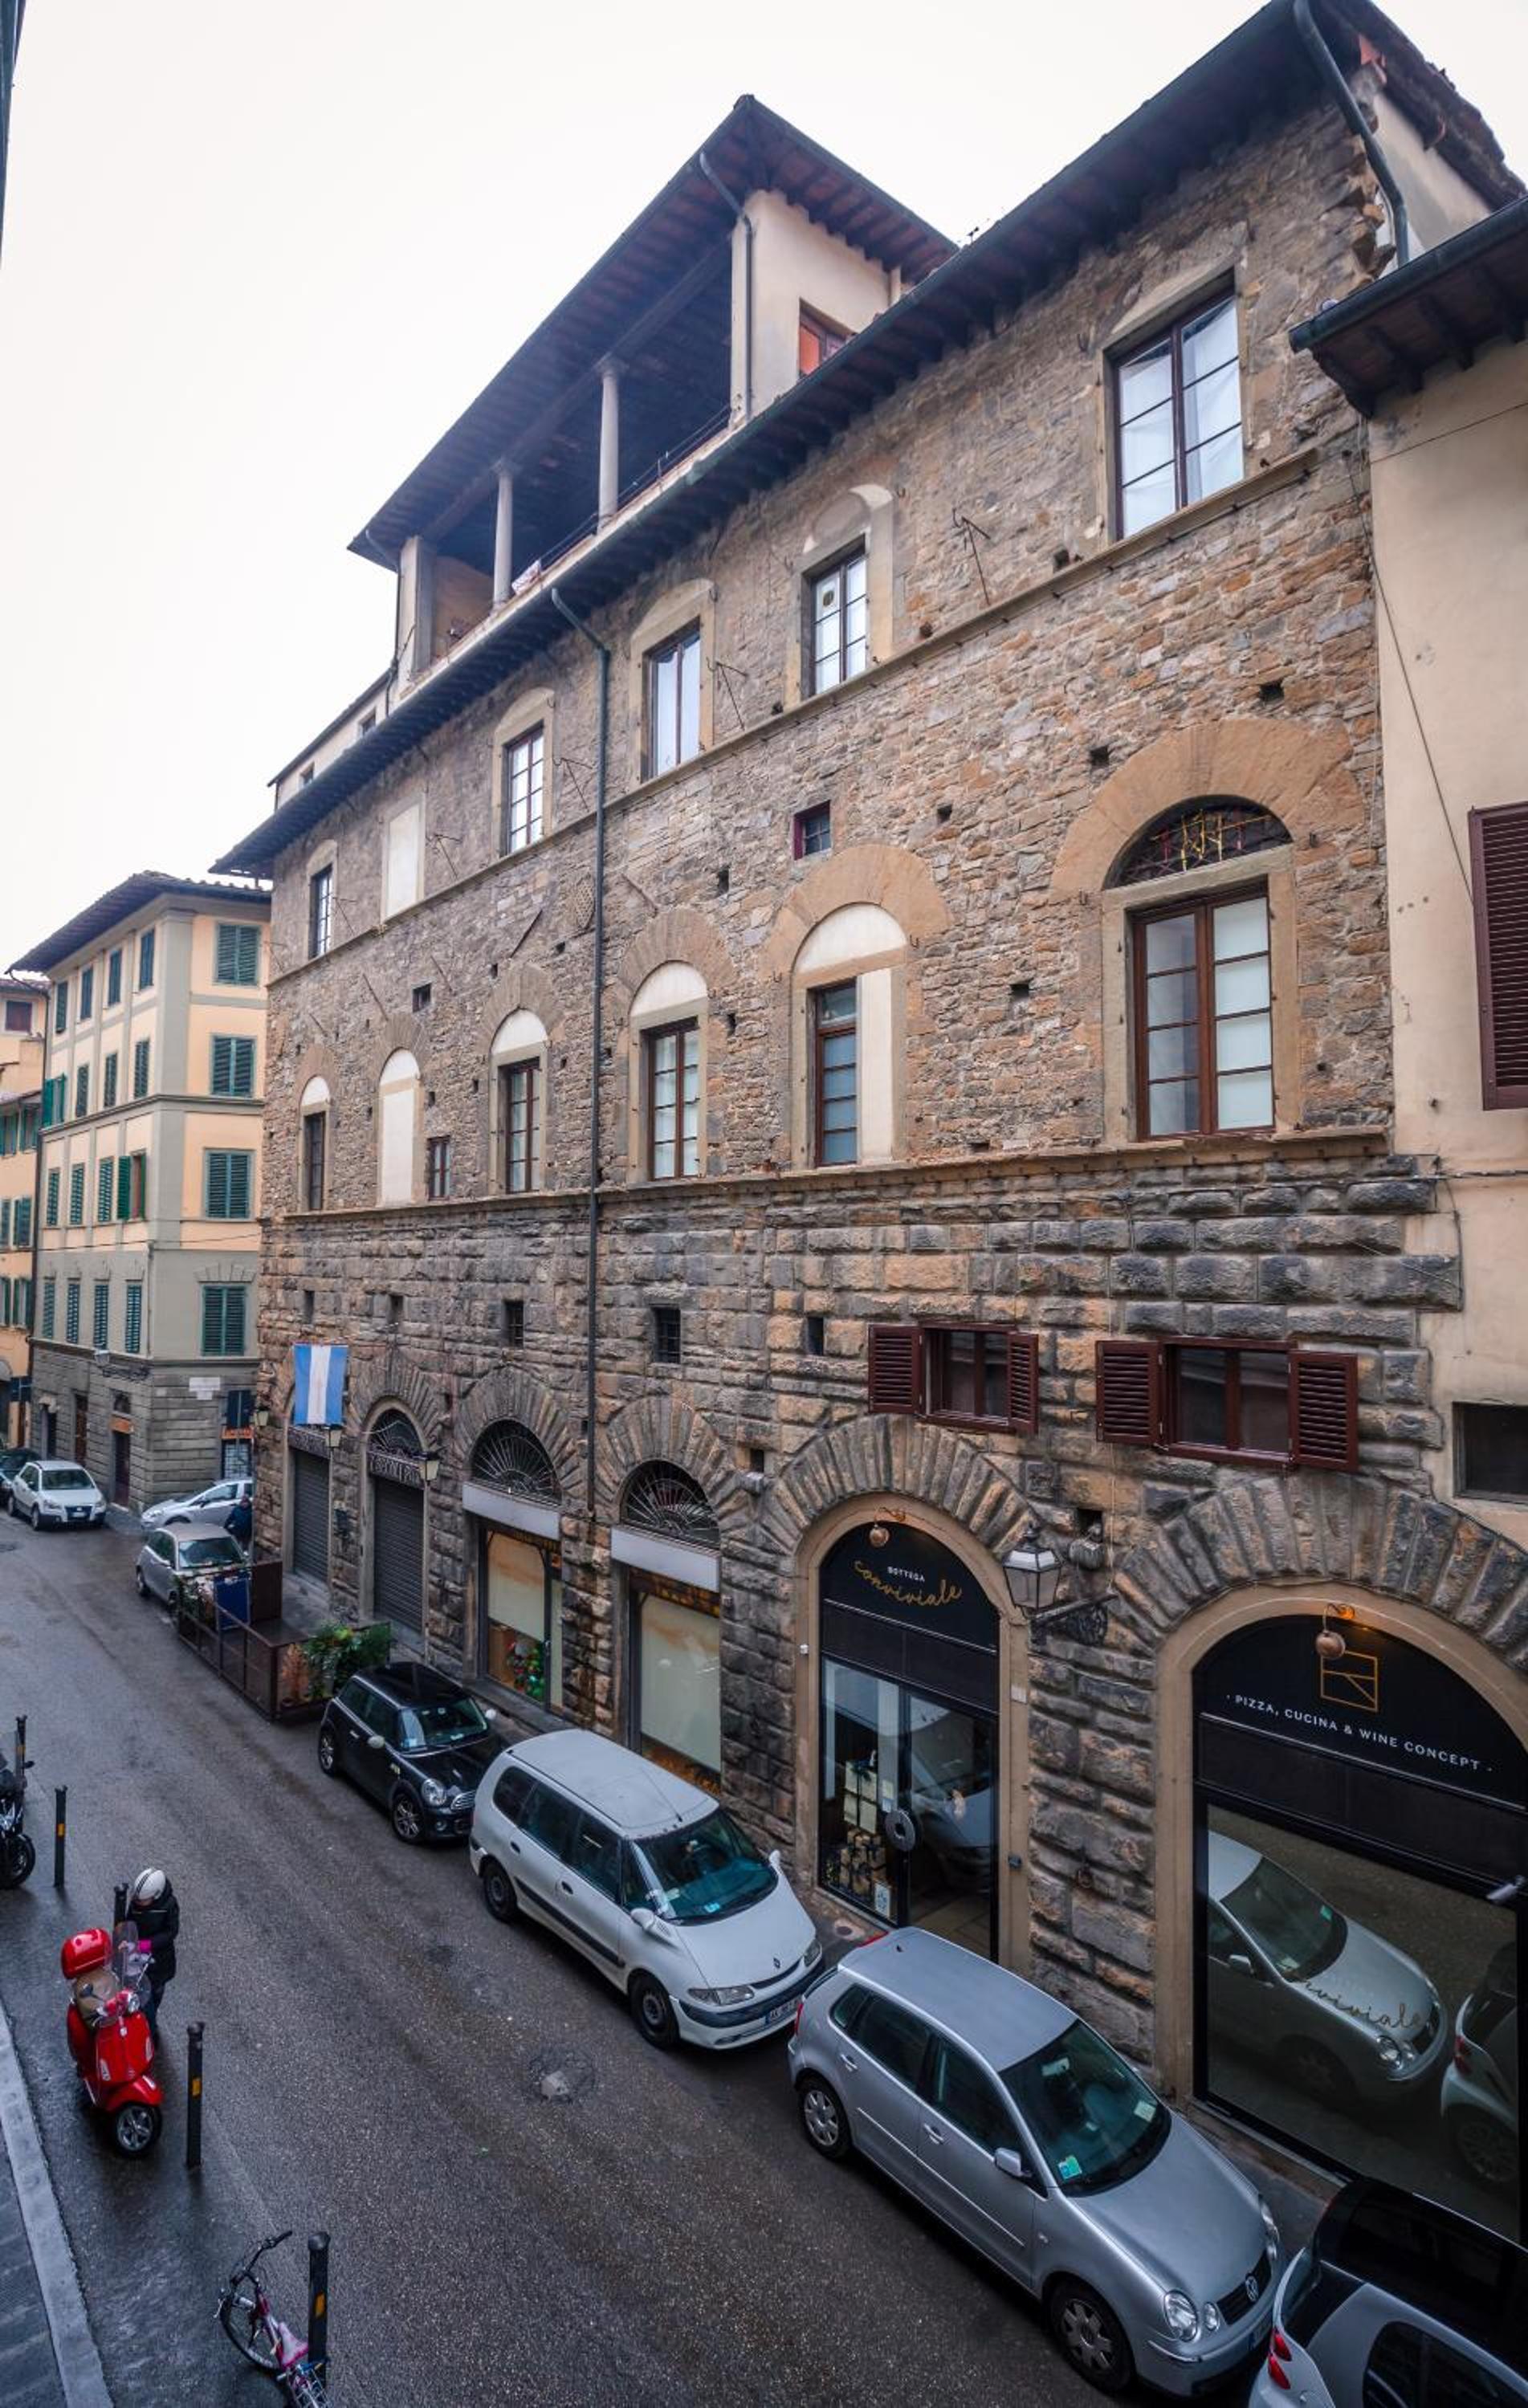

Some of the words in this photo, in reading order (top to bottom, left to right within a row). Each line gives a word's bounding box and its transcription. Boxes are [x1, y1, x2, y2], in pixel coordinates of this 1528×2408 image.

[887, 1566, 925, 1582] BOTTEGA
[1235, 1694, 1279, 1716] PIZZA,
[1285, 1709, 1338, 1731] CUCINA
[1343, 1724, 1353, 1735] &
[1359, 1728, 1398, 1748] WINE
[1404, 1741, 1480, 1771] CONCEPT
